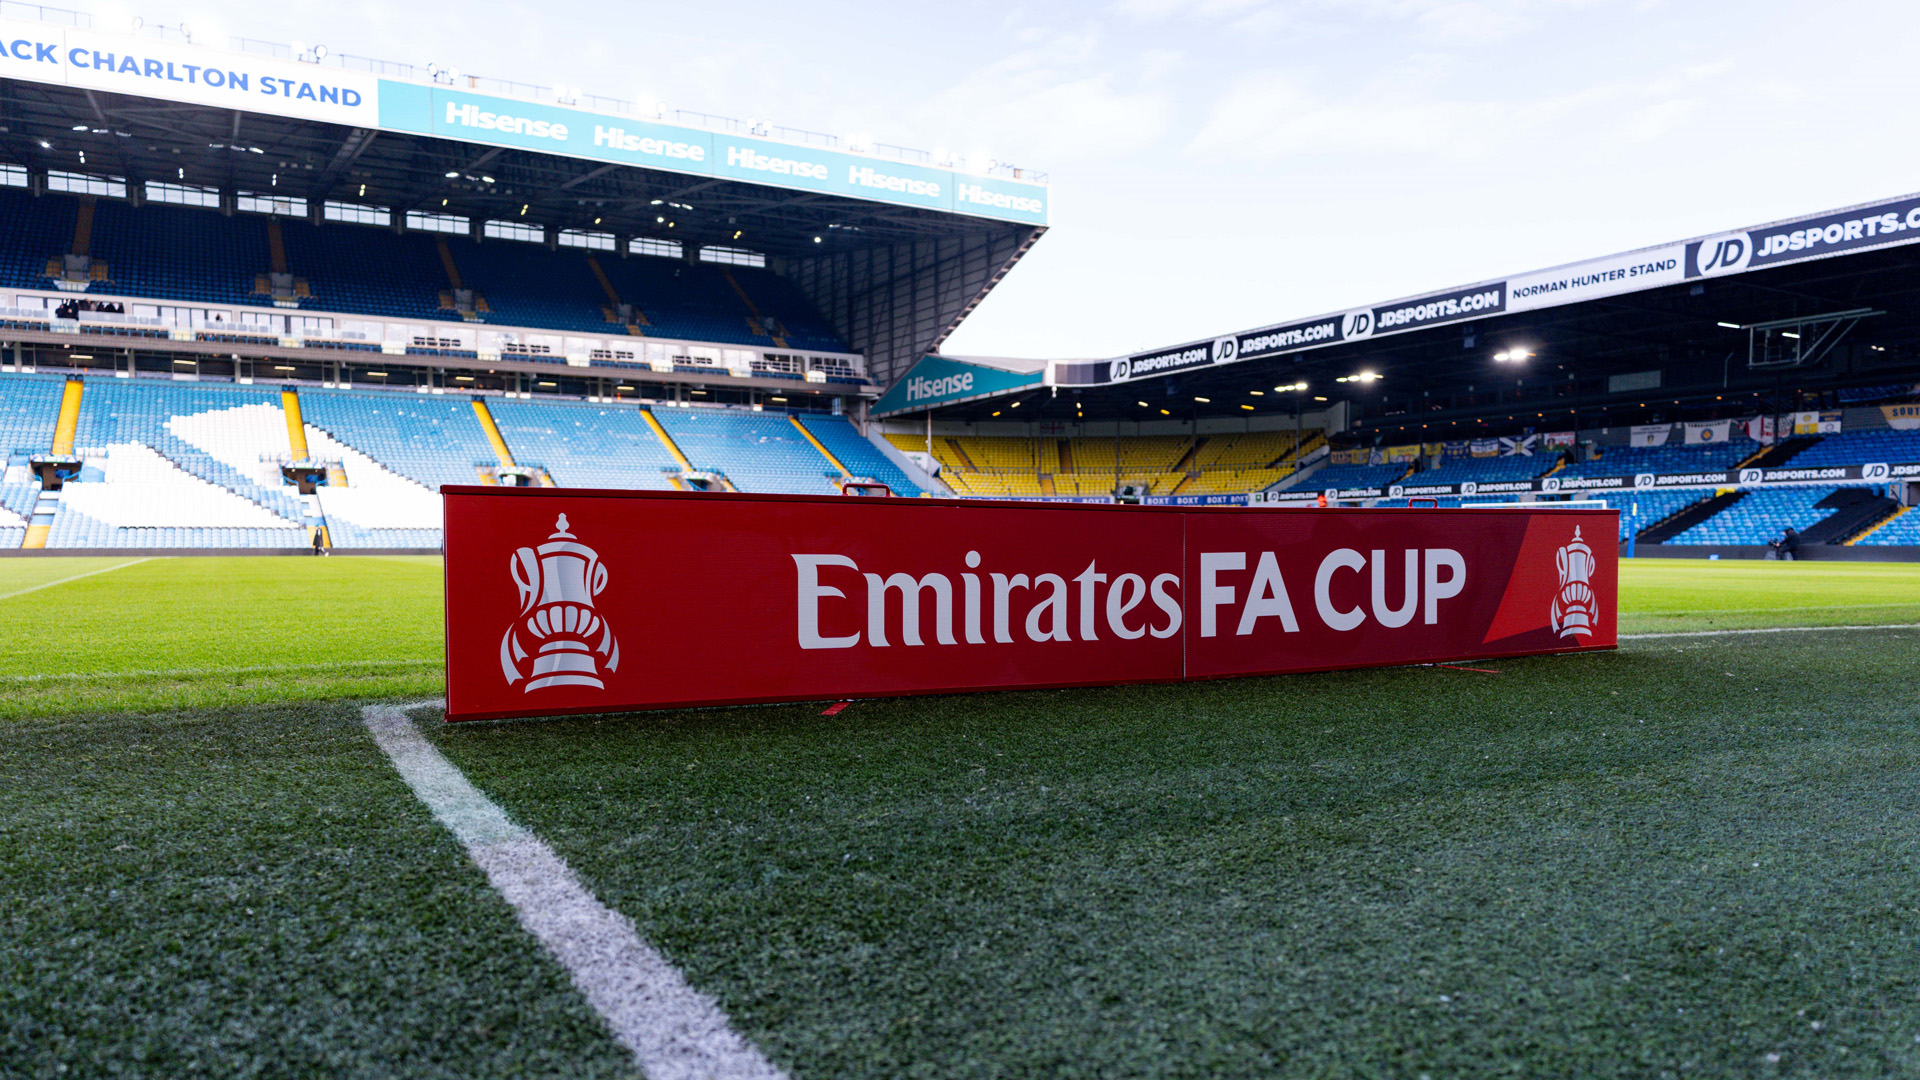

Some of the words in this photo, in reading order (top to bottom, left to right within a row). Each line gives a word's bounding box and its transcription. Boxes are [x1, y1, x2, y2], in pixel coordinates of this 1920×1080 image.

[69, 48, 249, 91] CHARLTON
[260, 76, 362, 107] STAND
[446, 102, 568, 141] Hisense
[594, 125, 705, 161] Hisense
[727, 146, 828, 180] Hisense
[848, 165, 940, 197] Hisense
[958, 183, 1042, 213] Hisense
[1704, 238, 1744, 271] JD
[1757, 207, 1920, 257] JDSPORTS.C
[1513, 280, 1568, 299] NORMAN
[1572, 268, 1626, 288] HUNTER
[1630, 259, 1677, 277] STAND
[1346, 314, 1369, 336] JD
[1377, 290, 1500, 328] JDSPORTS.COM
[1216, 340, 1234, 360] JD
[1240, 323, 1335, 354] JDSPORTS.COM
[1132, 348, 1207, 374] JDSPORTS.COM
[907, 372, 974, 401] Hisense
[1478, 482, 1532, 492] JDSPORTS.COM
[1561, 478, 1622, 488] JDSPORTS.COM
[1656, 474, 1726, 484] JDSPORTS.COM
[1764, 468, 1846, 480] JDSPORTS.COM
[791, 550, 1183, 650] Emirates
[1200, 551, 1300, 638] FA
[1314, 548, 1467, 632] CUP
